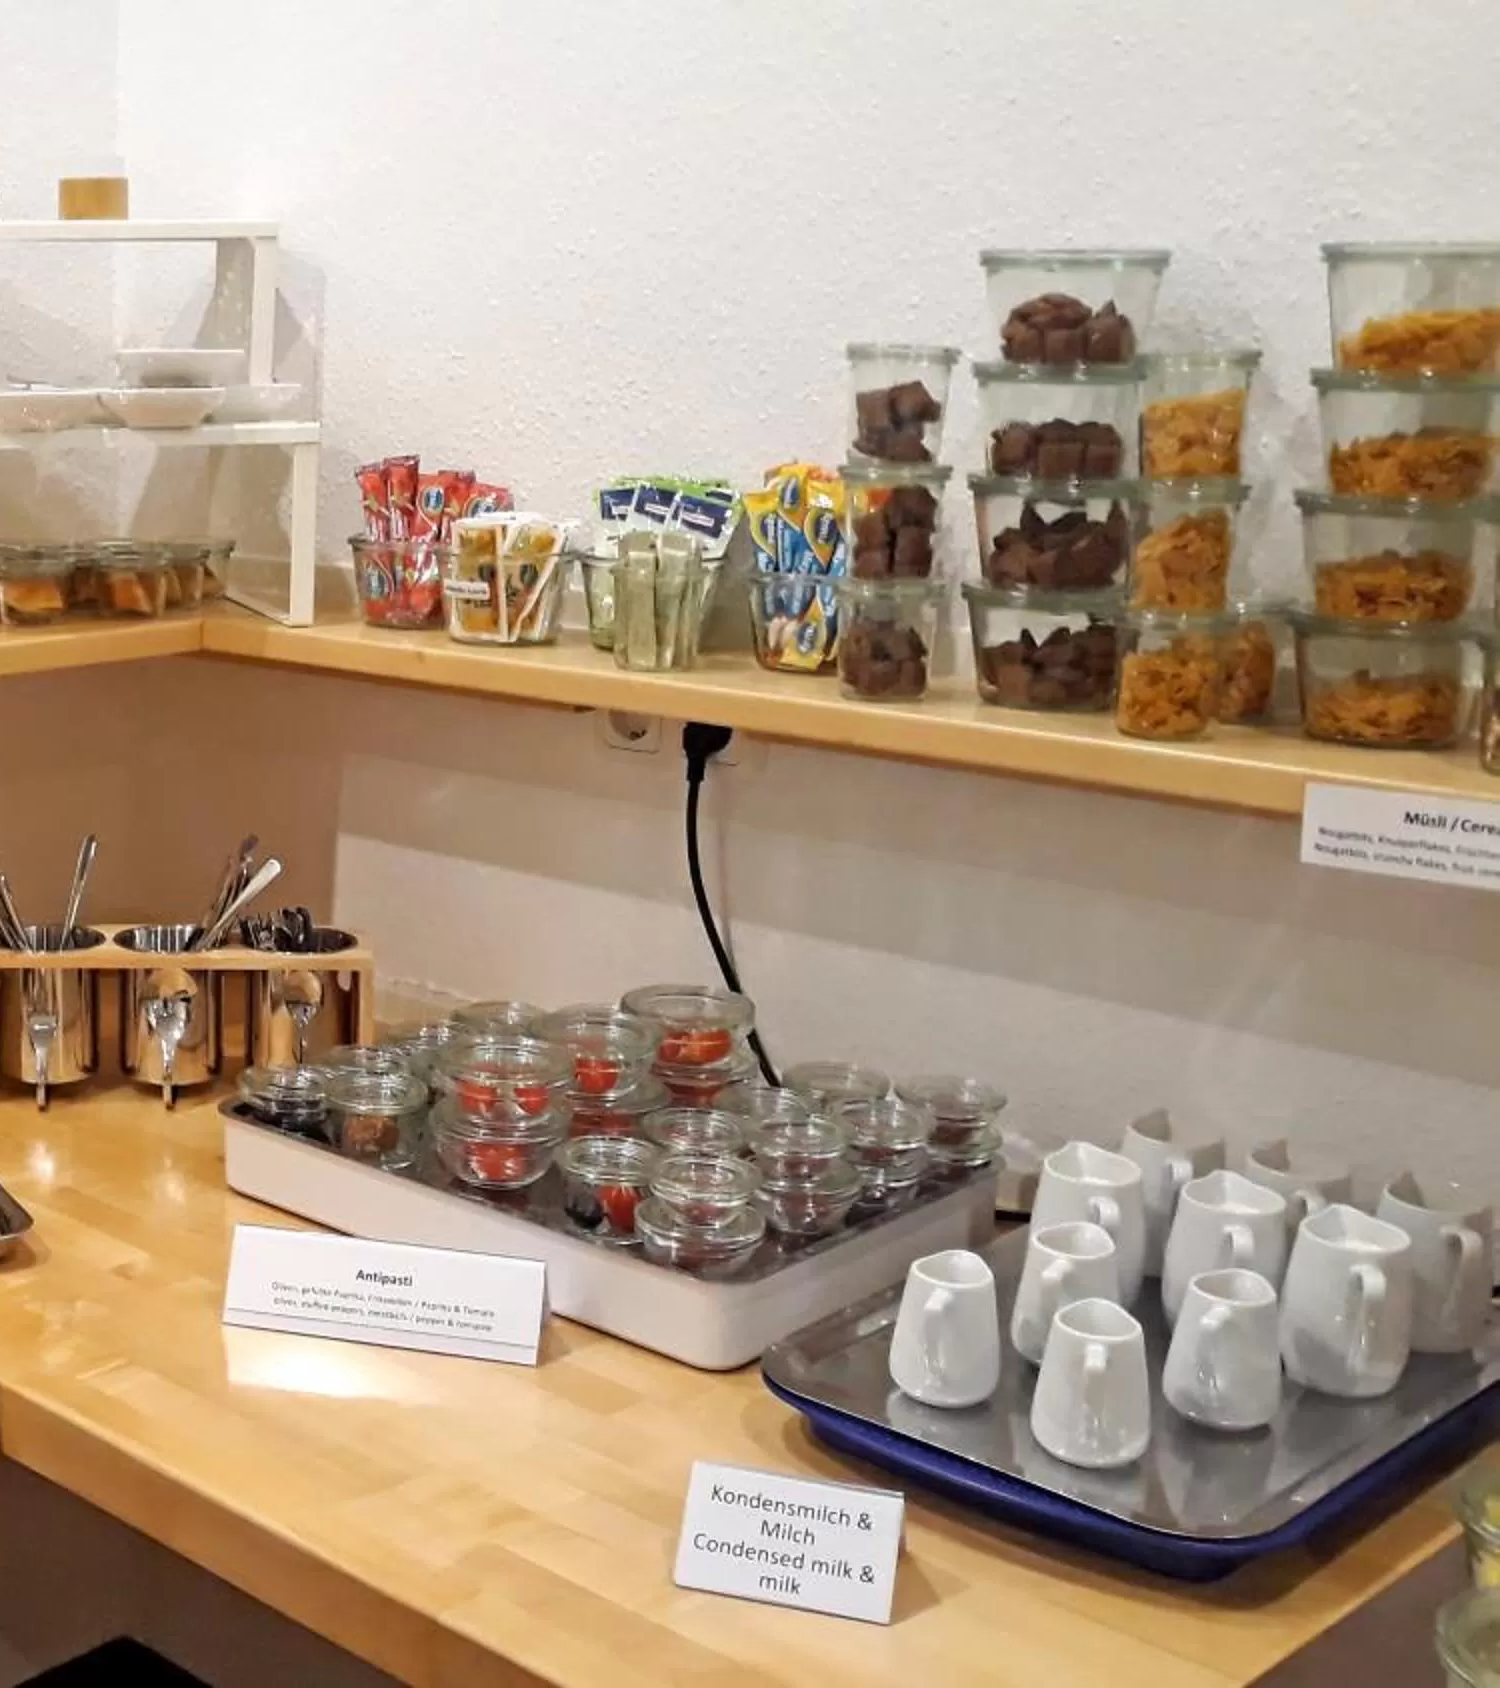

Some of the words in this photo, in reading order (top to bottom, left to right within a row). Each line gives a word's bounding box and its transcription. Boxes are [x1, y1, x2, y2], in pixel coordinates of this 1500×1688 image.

[1404, 811, 1447, 829] Müsli
[1449, 816, 1460, 832] /
[355, 1269, 413, 1288] Antipasti
[711, 1484, 851, 1527] Kondensmilch
[857, 1511, 873, 1531] &
[760, 1519, 816, 1546] Milch
[693, 1532, 805, 1570] Condensed
[811, 1557, 853, 1580] milk
[859, 1565, 875, 1584] &
[758, 1573, 801, 1595] milk
